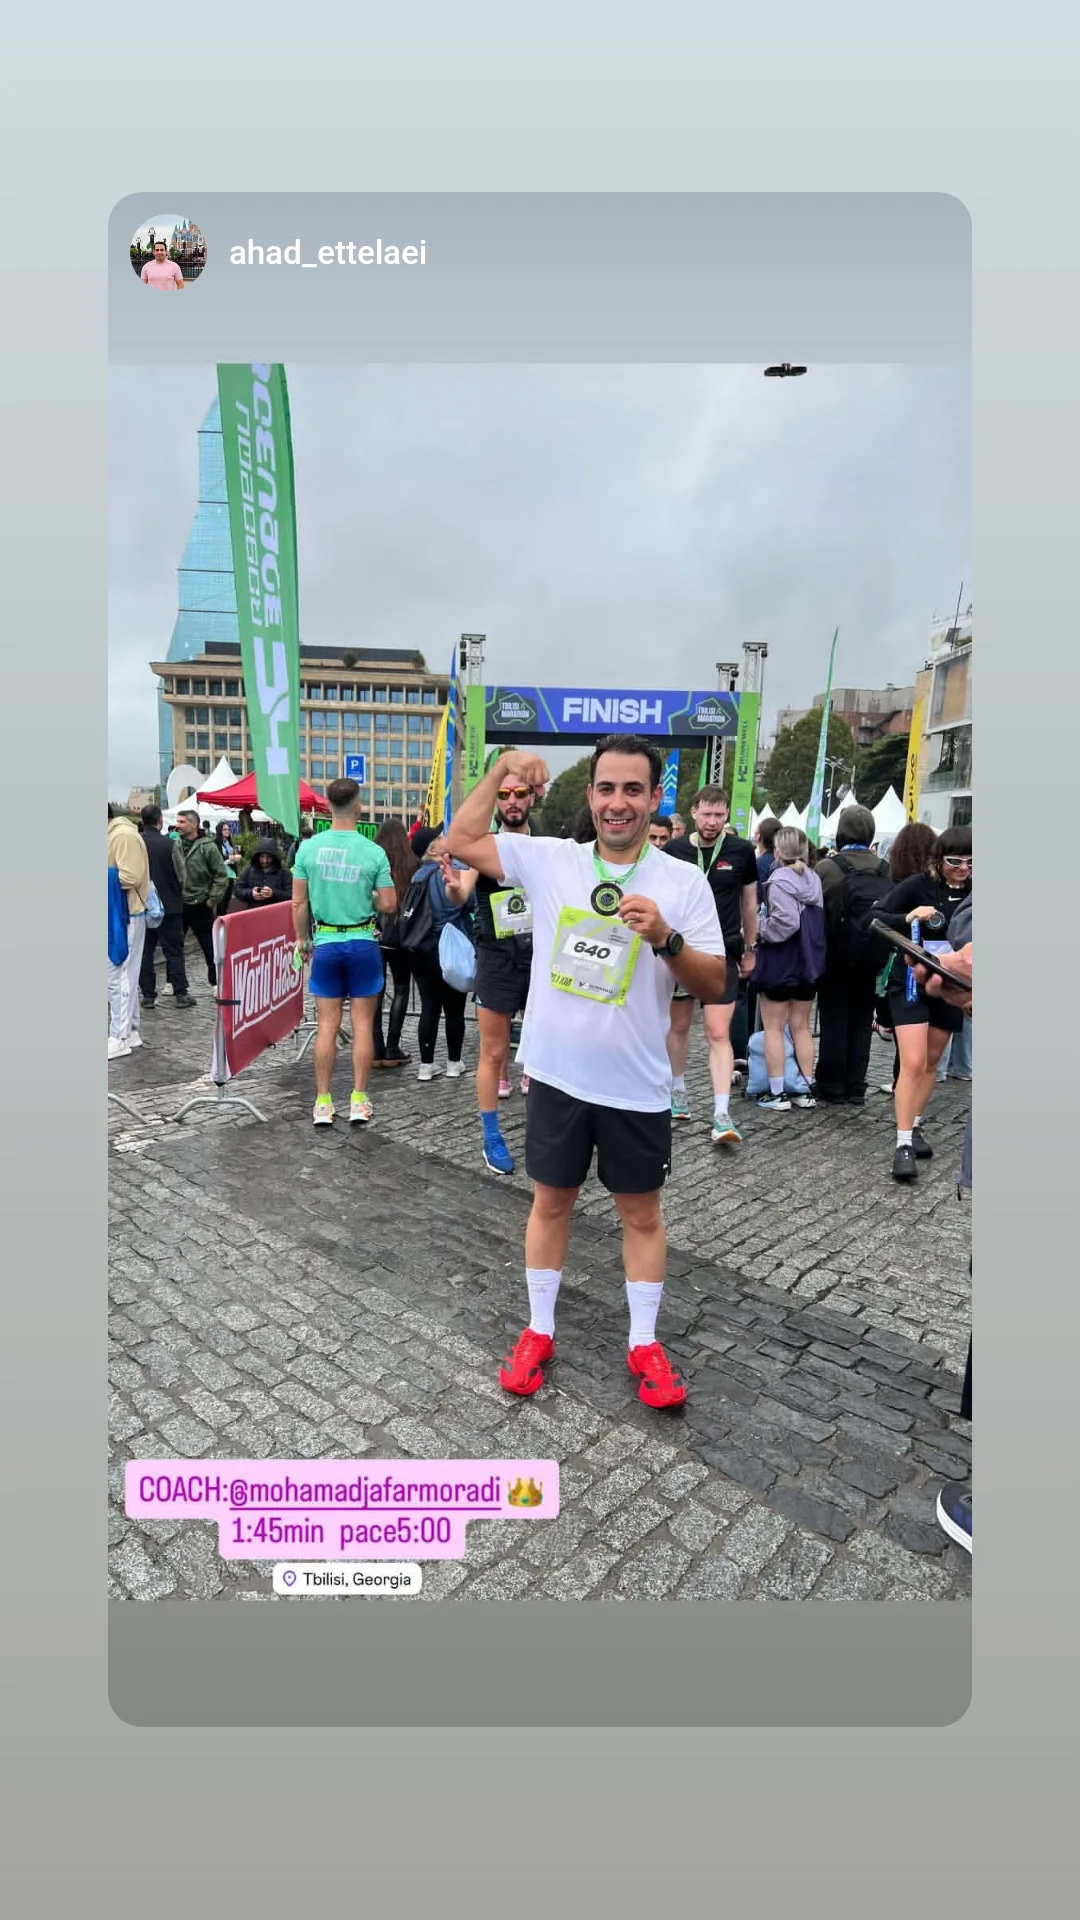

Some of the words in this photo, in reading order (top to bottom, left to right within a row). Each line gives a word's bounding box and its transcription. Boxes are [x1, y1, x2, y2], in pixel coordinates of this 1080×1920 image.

[562, 697, 662, 724] FINISH
[350, 759, 360, 770] P
[573, 941, 611, 960] 640
[234, 951, 271, 1025] World
